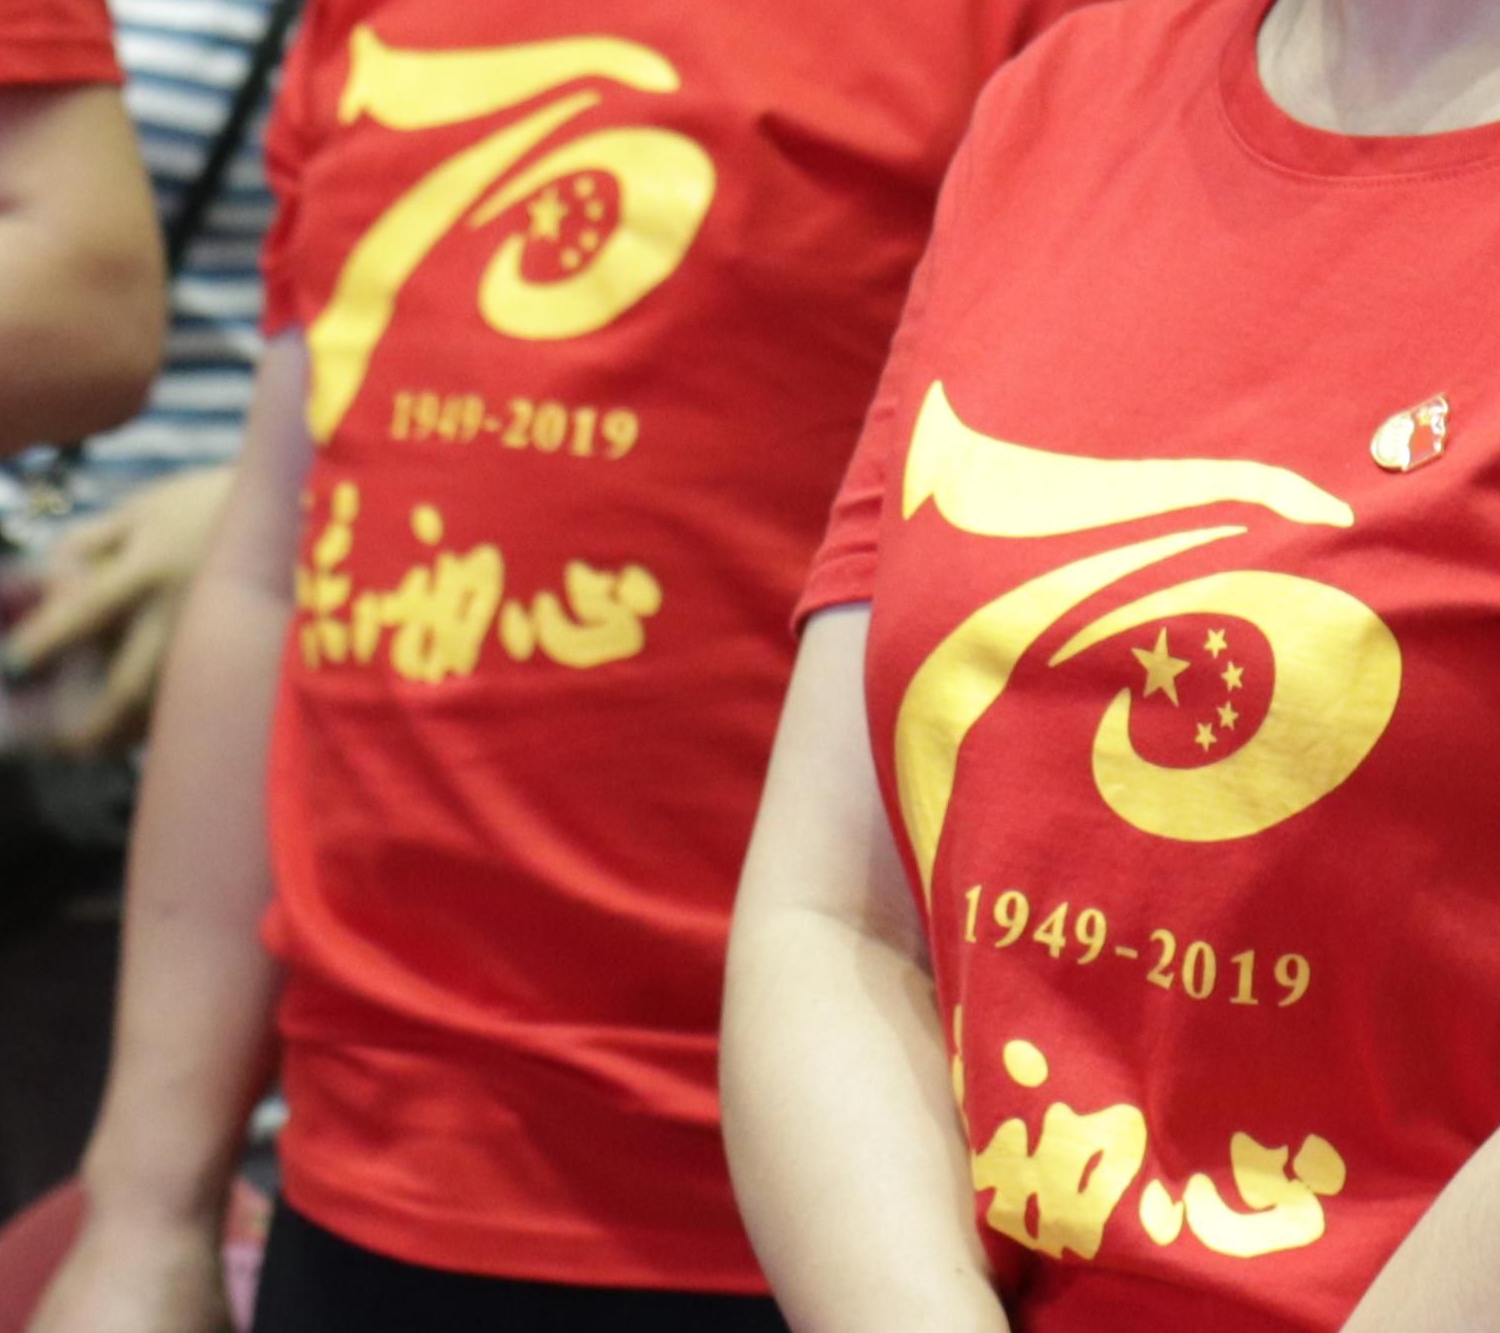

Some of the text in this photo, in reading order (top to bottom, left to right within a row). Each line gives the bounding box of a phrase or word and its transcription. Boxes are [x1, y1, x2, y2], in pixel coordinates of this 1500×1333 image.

[306, 24, 717, 446] 70
[390, 391, 640, 459] 1949-2019
[895, 380, 1403, 911] 70
[964, 884, 1311, 1007] 1949-2019
